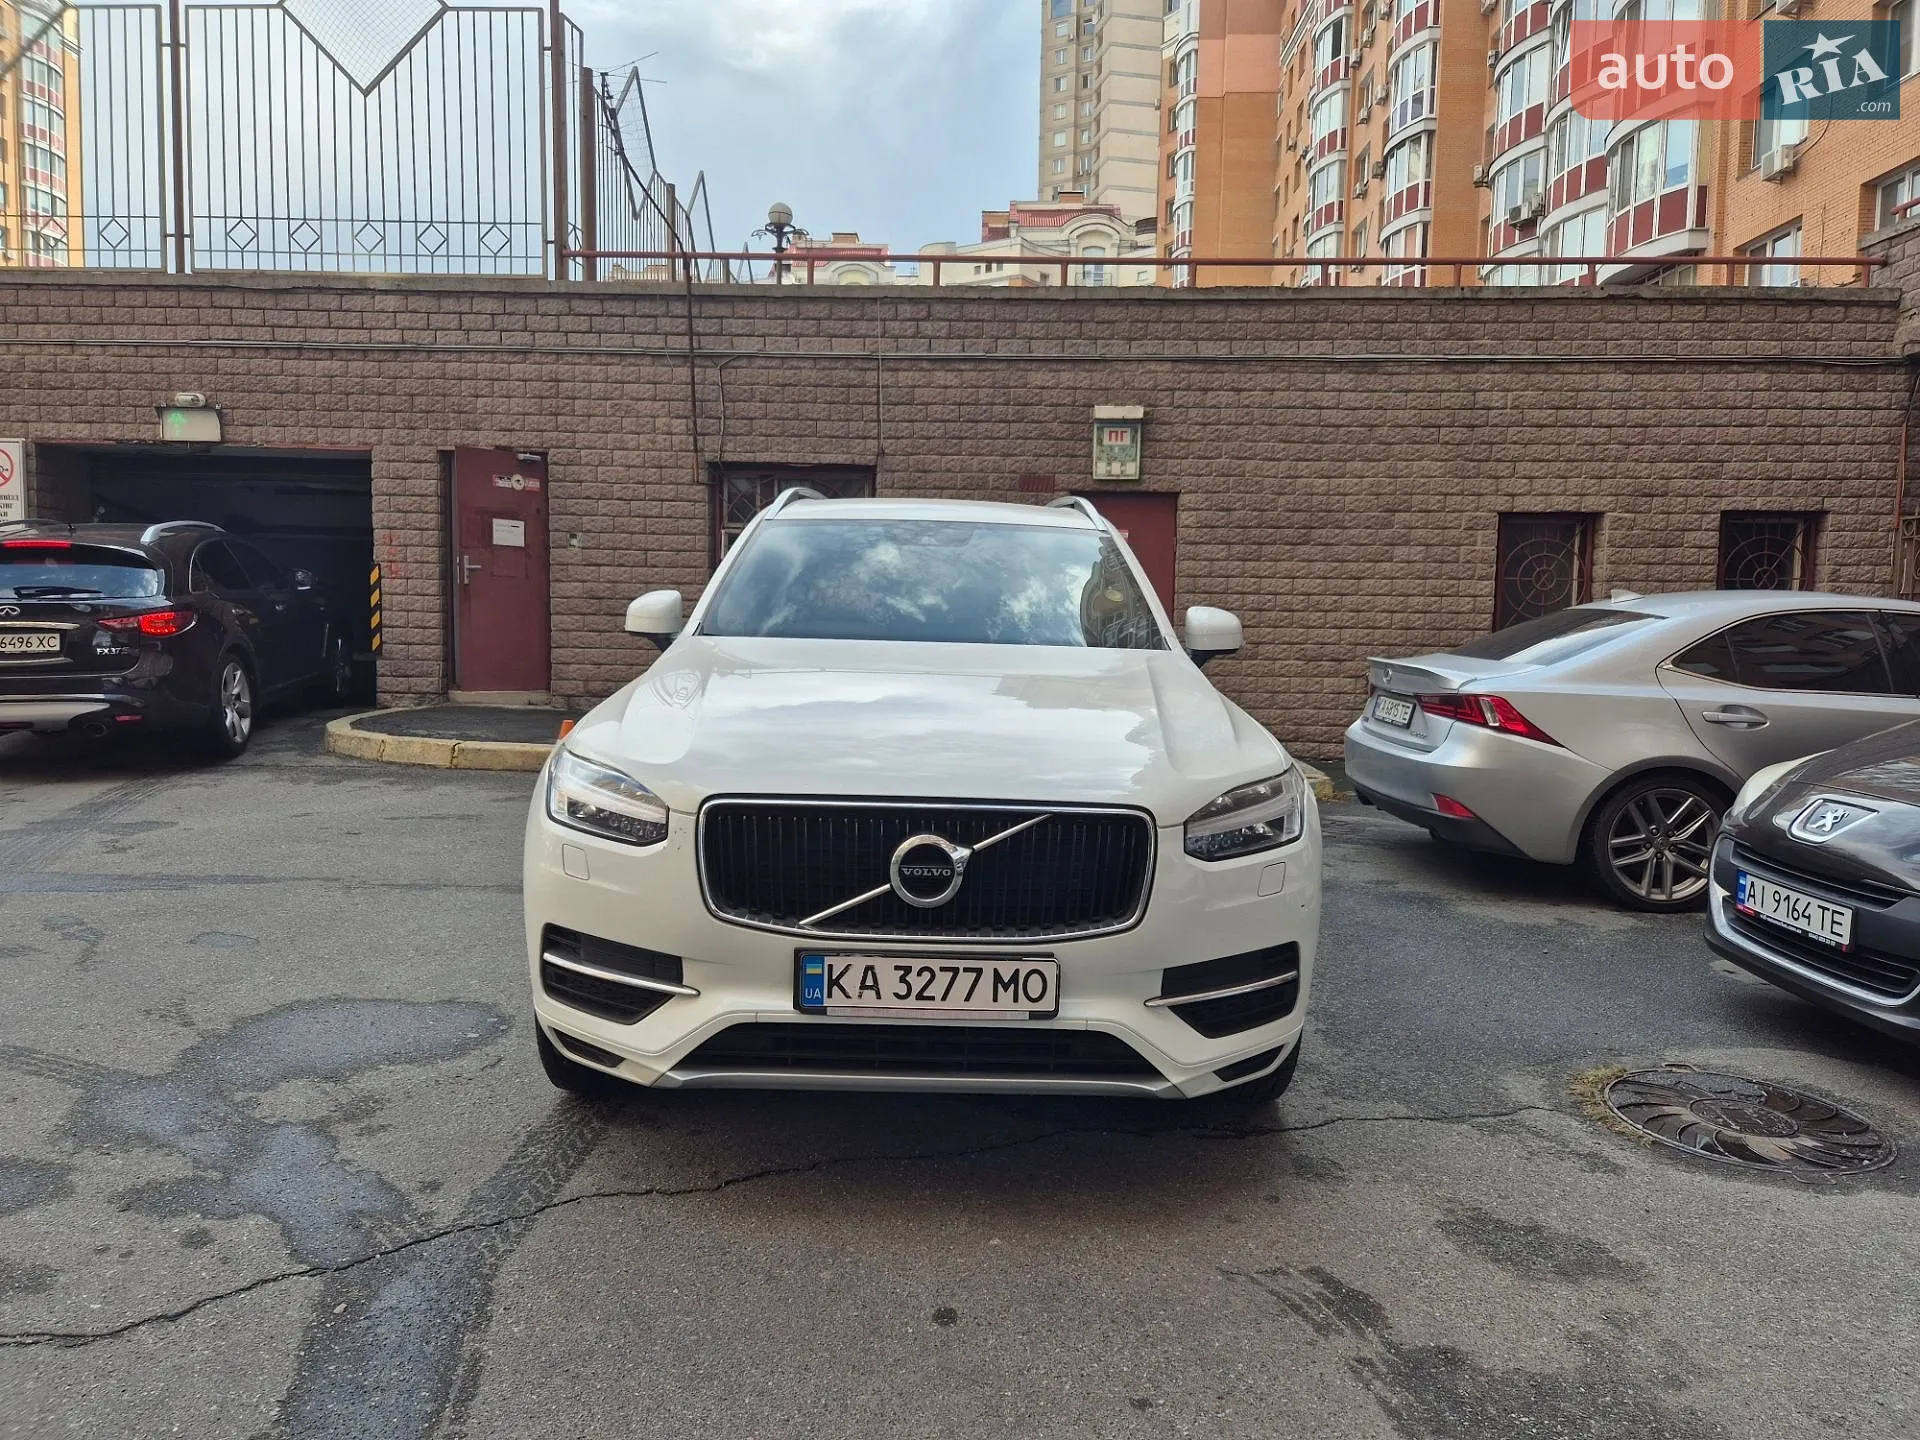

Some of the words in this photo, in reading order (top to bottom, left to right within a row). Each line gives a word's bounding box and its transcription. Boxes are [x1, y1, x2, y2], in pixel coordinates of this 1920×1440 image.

[1109, 430, 1128, 442] ПГ
[36, 636, 57, 648] XC
[900, 868, 951, 876] VOLVO
[1772, 890, 1811, 926] 9164
[1817, 904, 1845, 938] TE
[827, 963, 882, 1000] KA
[892, 965, 984, 1002] 3277
[992, 967, 1048, 1004] MO
[805, 989, 822, 999] UA
